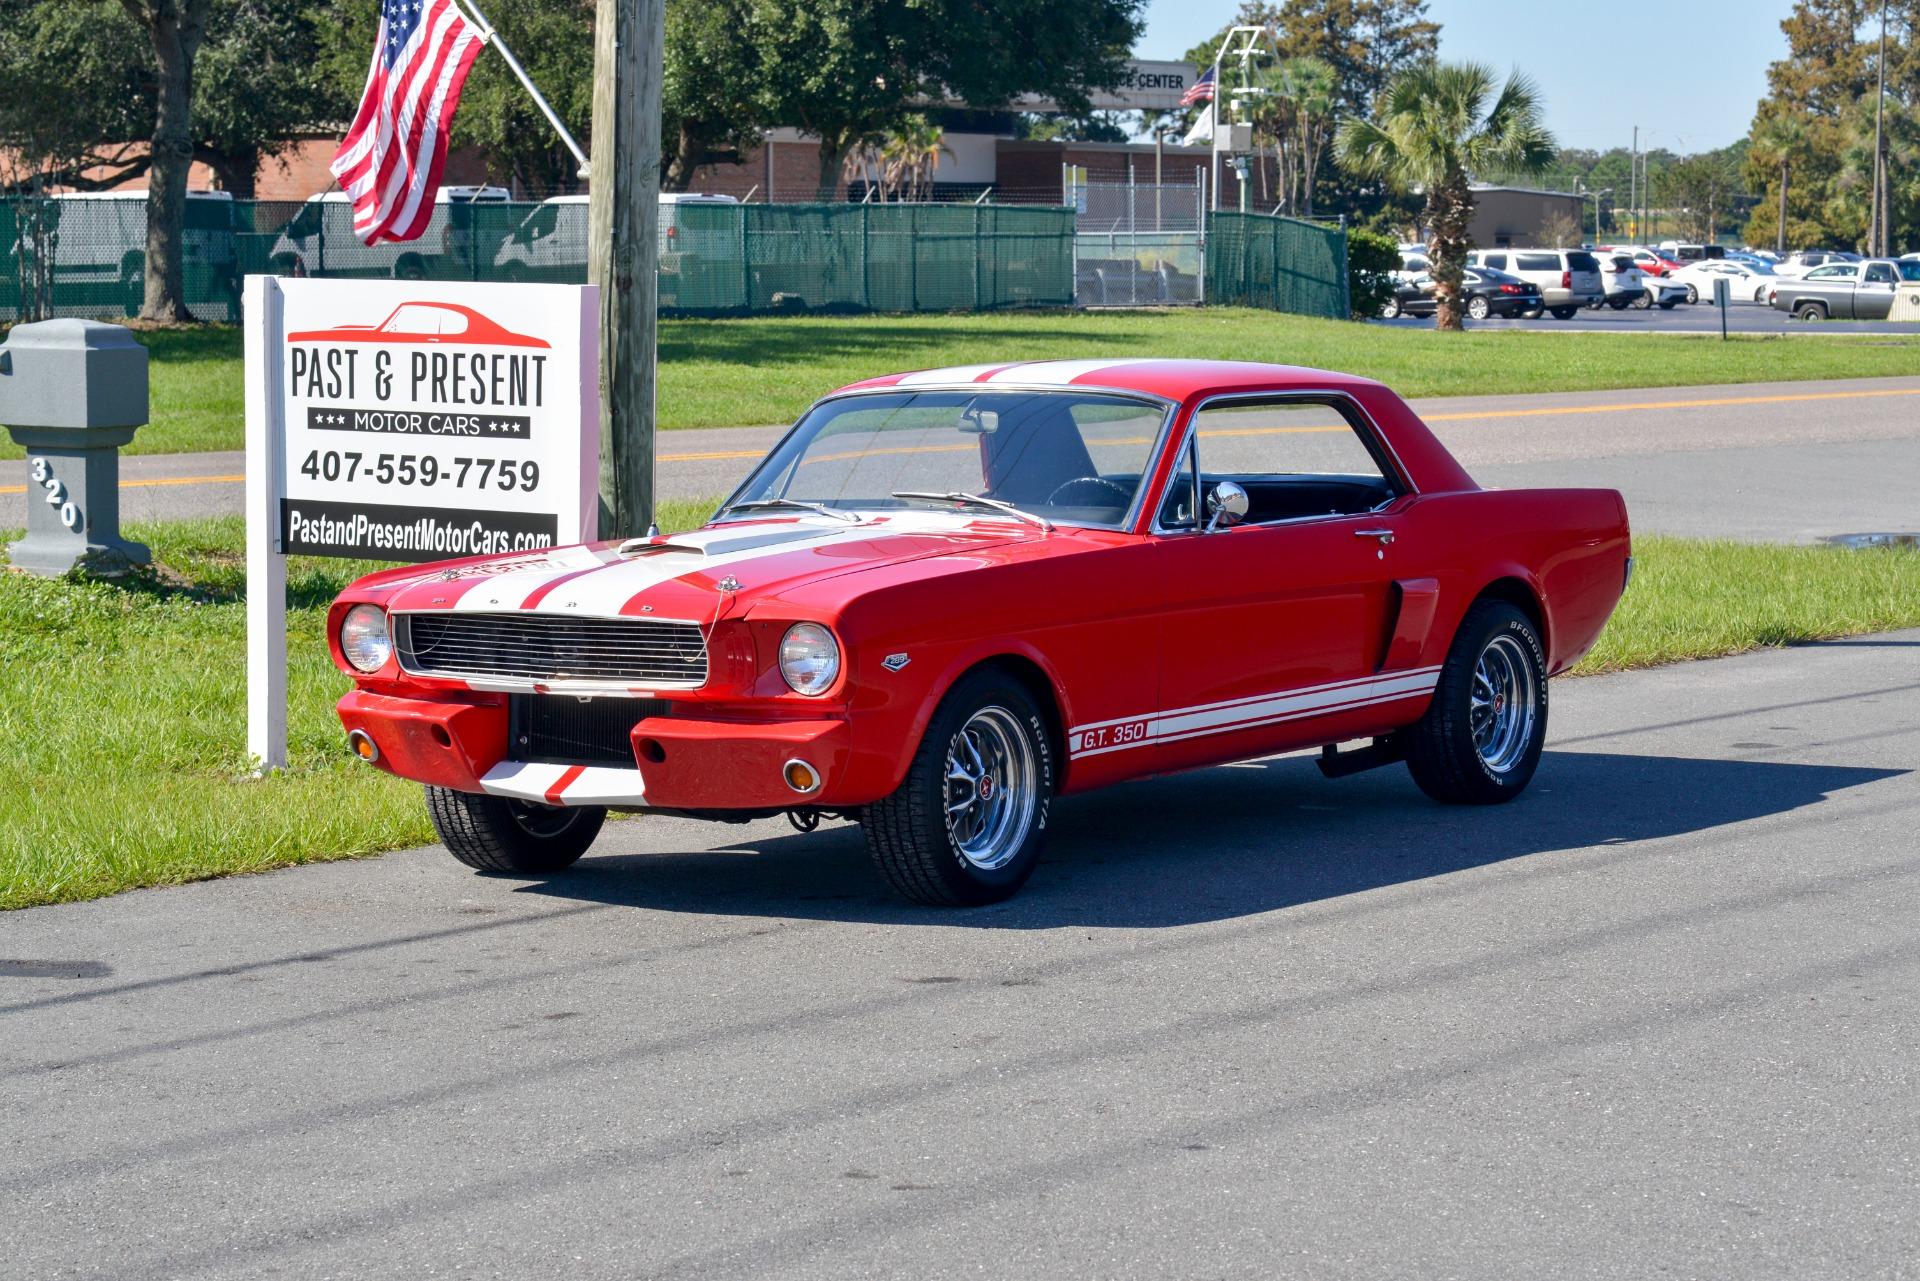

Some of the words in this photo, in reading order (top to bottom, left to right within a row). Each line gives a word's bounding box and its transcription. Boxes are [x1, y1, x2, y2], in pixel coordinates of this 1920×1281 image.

[1138, 73, 1184, 89] CENTER
[291, 347, 358, 400] PAST
[375, 350, 394, 401] &
[411, 351, 547, 407] PRESENT
[354, 412, 423, 433] MOTOR
[428, 415, 481, 436] CARS
[301, 450, 540, 492] 407-559-7759
[289, 510, 551, 553] PastandPresentMotorCars.com
[1510, 621, 1547, 705] BFGoodrich
[1029, 715, 1050, 787] Radial
[1084, 729, 1107, 749] G.T.
[1113, 722, 1144, 743] 350
